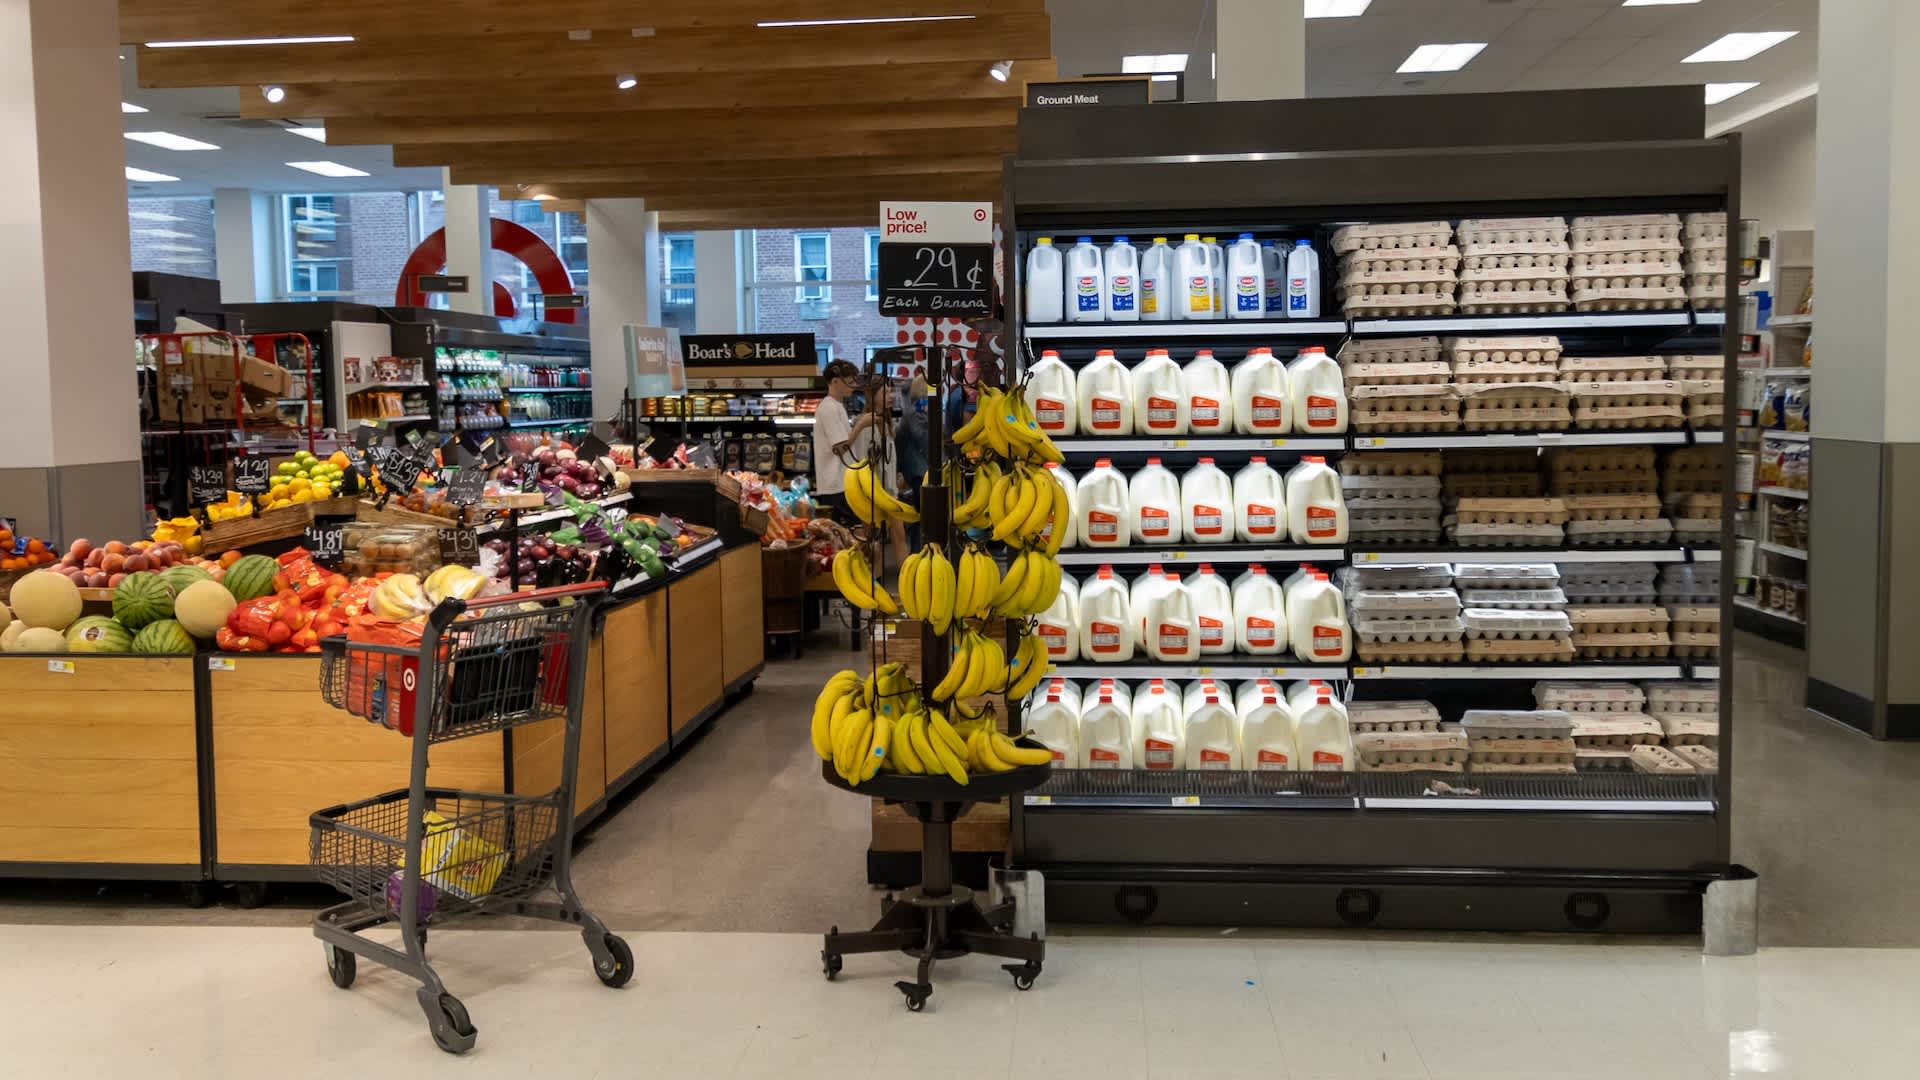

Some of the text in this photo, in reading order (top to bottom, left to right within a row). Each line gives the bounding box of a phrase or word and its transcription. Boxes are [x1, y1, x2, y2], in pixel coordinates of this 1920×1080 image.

[1037, 94, 1099, 105] Ground Meat
[887, 207, 918, 221] Low
[887, 220, 928, 236] price!
[882, 296, 919, 309] Each
[688, 341, 796, 360] Boar's Head
